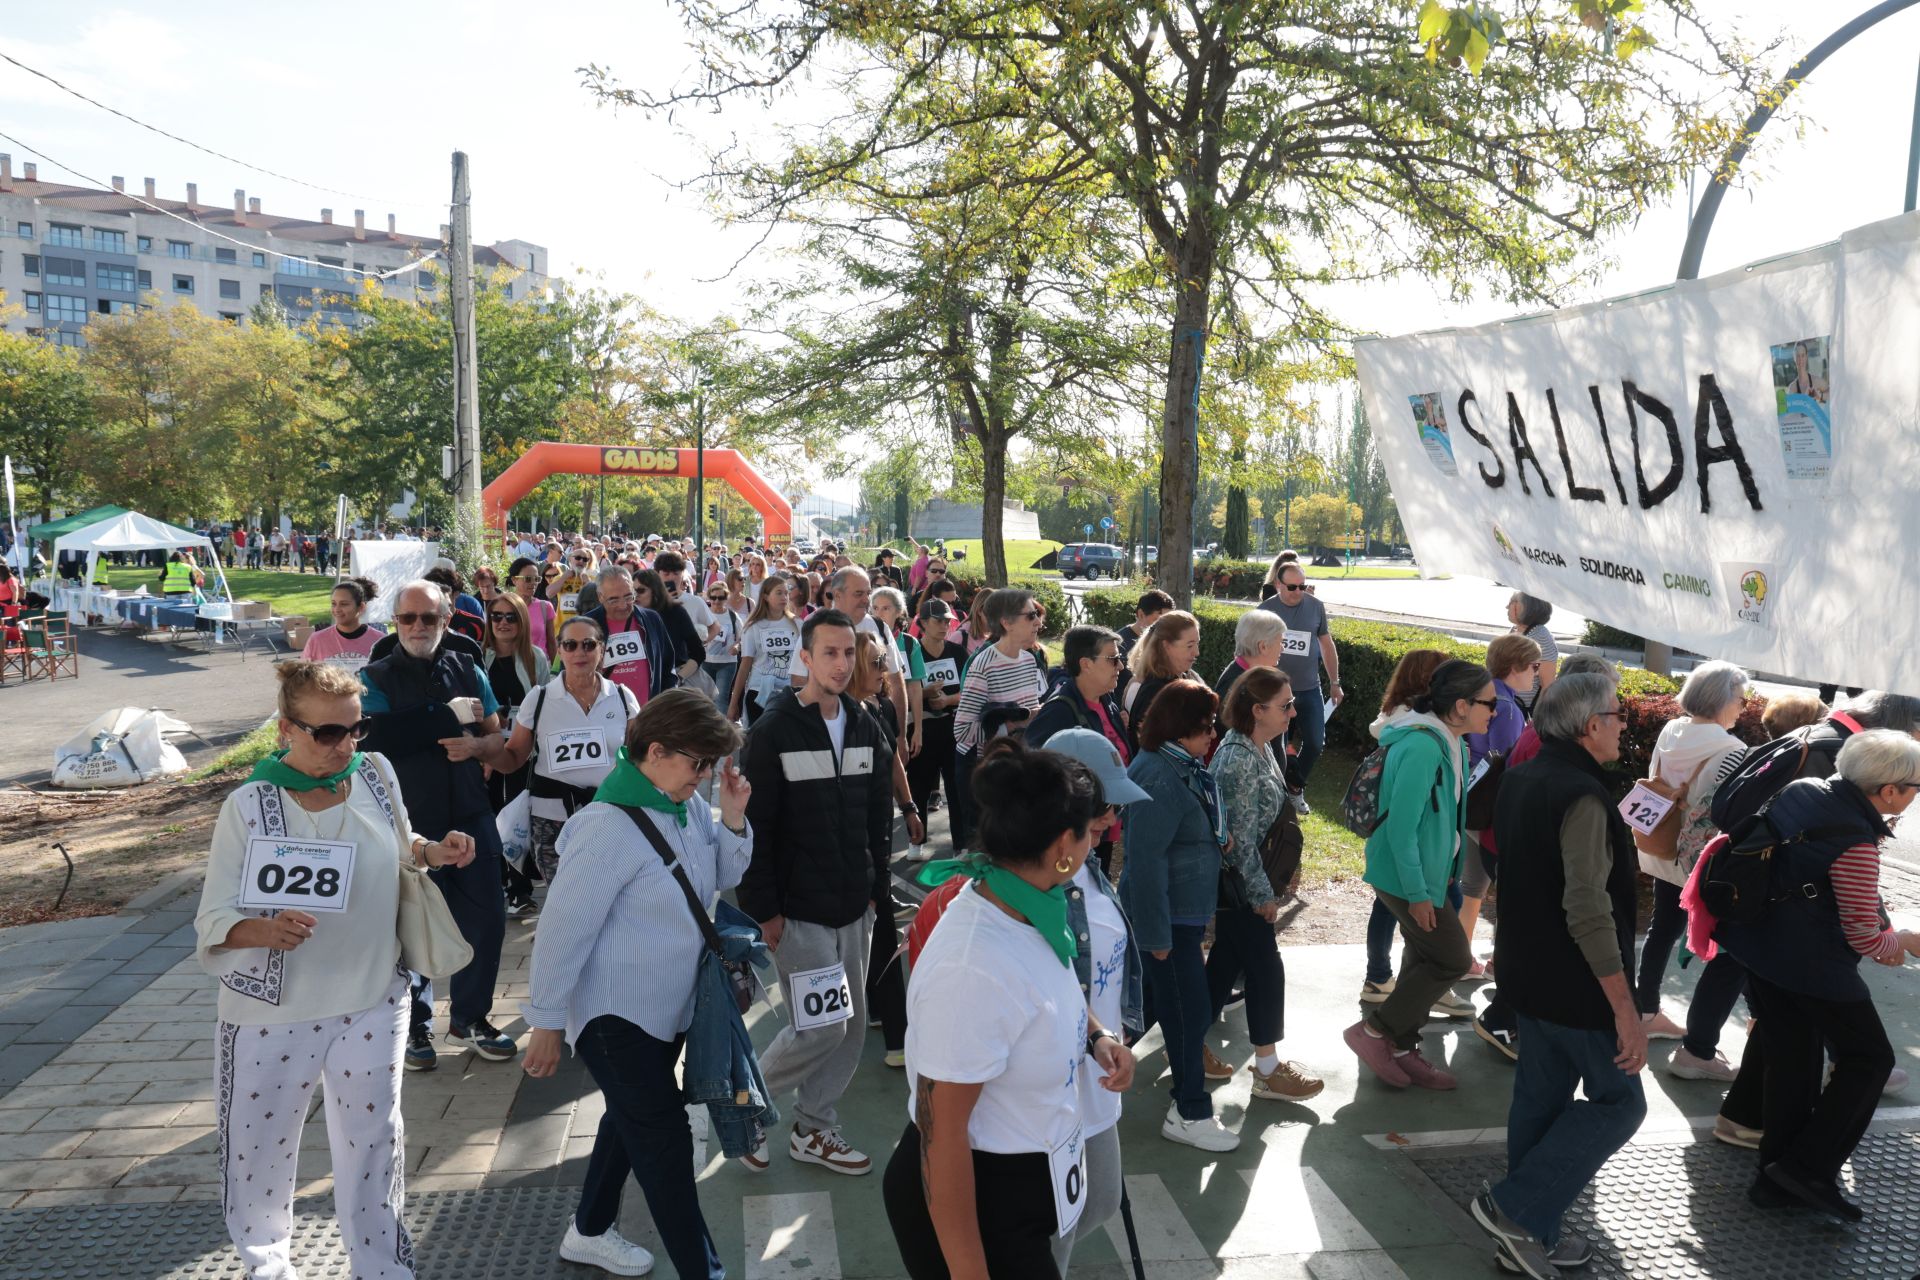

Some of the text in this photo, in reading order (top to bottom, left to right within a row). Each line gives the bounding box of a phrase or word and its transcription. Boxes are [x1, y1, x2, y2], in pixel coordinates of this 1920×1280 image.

[1457, 373, 1763, 514] SALIDA
[604, 449, 678, 471] GADIS
[1579, 557, 1646, 585] SOLIDARIA
[1663, 572, 1711, 597] CAMINO
[605, 642, 639, 659] 189
[766, 637, 791, 648] 389
[1281, 638, 1307, 651] 529
[613, 666, 636, 674] adidas
[927, 669, 955, 682] 490
[554, 741, 602, 763] 270
[1628, 802, 1660, 827] 123
[257, 863, 340, 897] 028
[803, 984, 849, 1016] 026
